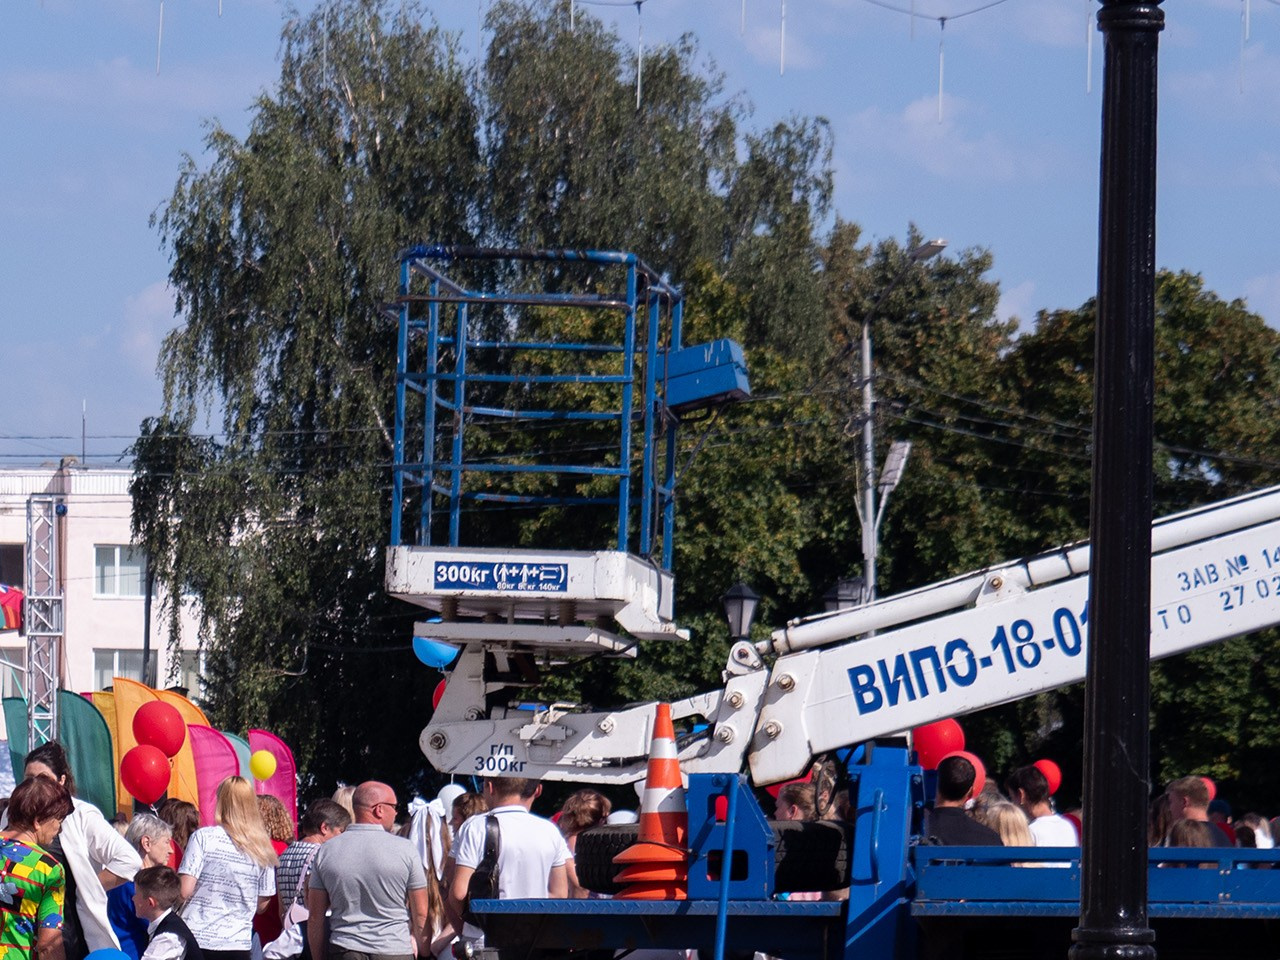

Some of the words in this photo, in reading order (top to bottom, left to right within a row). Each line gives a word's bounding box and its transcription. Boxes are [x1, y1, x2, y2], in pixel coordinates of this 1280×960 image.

[436, 565, 490, 583] 300кг
[539, 583, 561, 591] 140кг
[475, 756, 527, 772] 300кг
